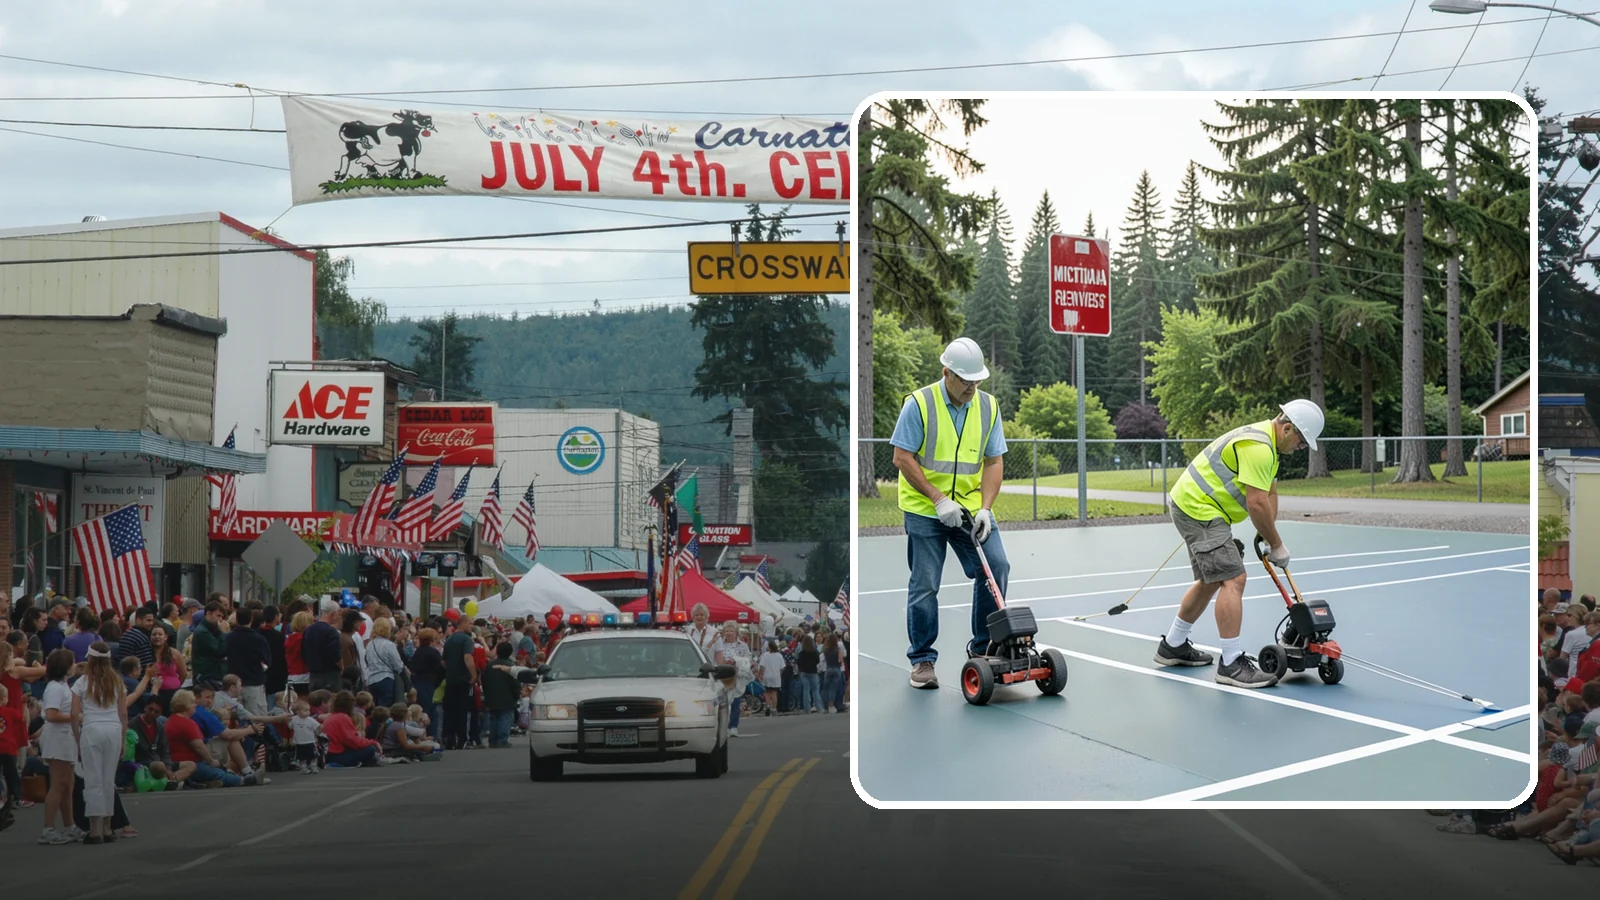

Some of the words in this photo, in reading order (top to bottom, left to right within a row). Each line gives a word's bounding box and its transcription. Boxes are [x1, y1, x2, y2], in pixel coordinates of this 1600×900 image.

[481, 141, 605, 192] JULY
[632, 150, 746, 197] 4th.
[697, 254, 851, 280] CROSSWA
[282, 380, 373, 420] ACE
[405, 409, 452, 422] CEDAR
[461, 409, 486, 422] LOG
[283, 421, 371, 436] Hardware
[416, 427, 477, 447] Coca-Cola
[353, 467, 385, 480] Simpl
[96, 484, 124, 495] Vincent
[126, 485, 136, 495] de
[137, 485, 155, 495] Paul
[212, 516, 331, 535] HARDARE
[688, 526, 742, 535] CRNATION
[699, 535, 731, 543] GLASS
